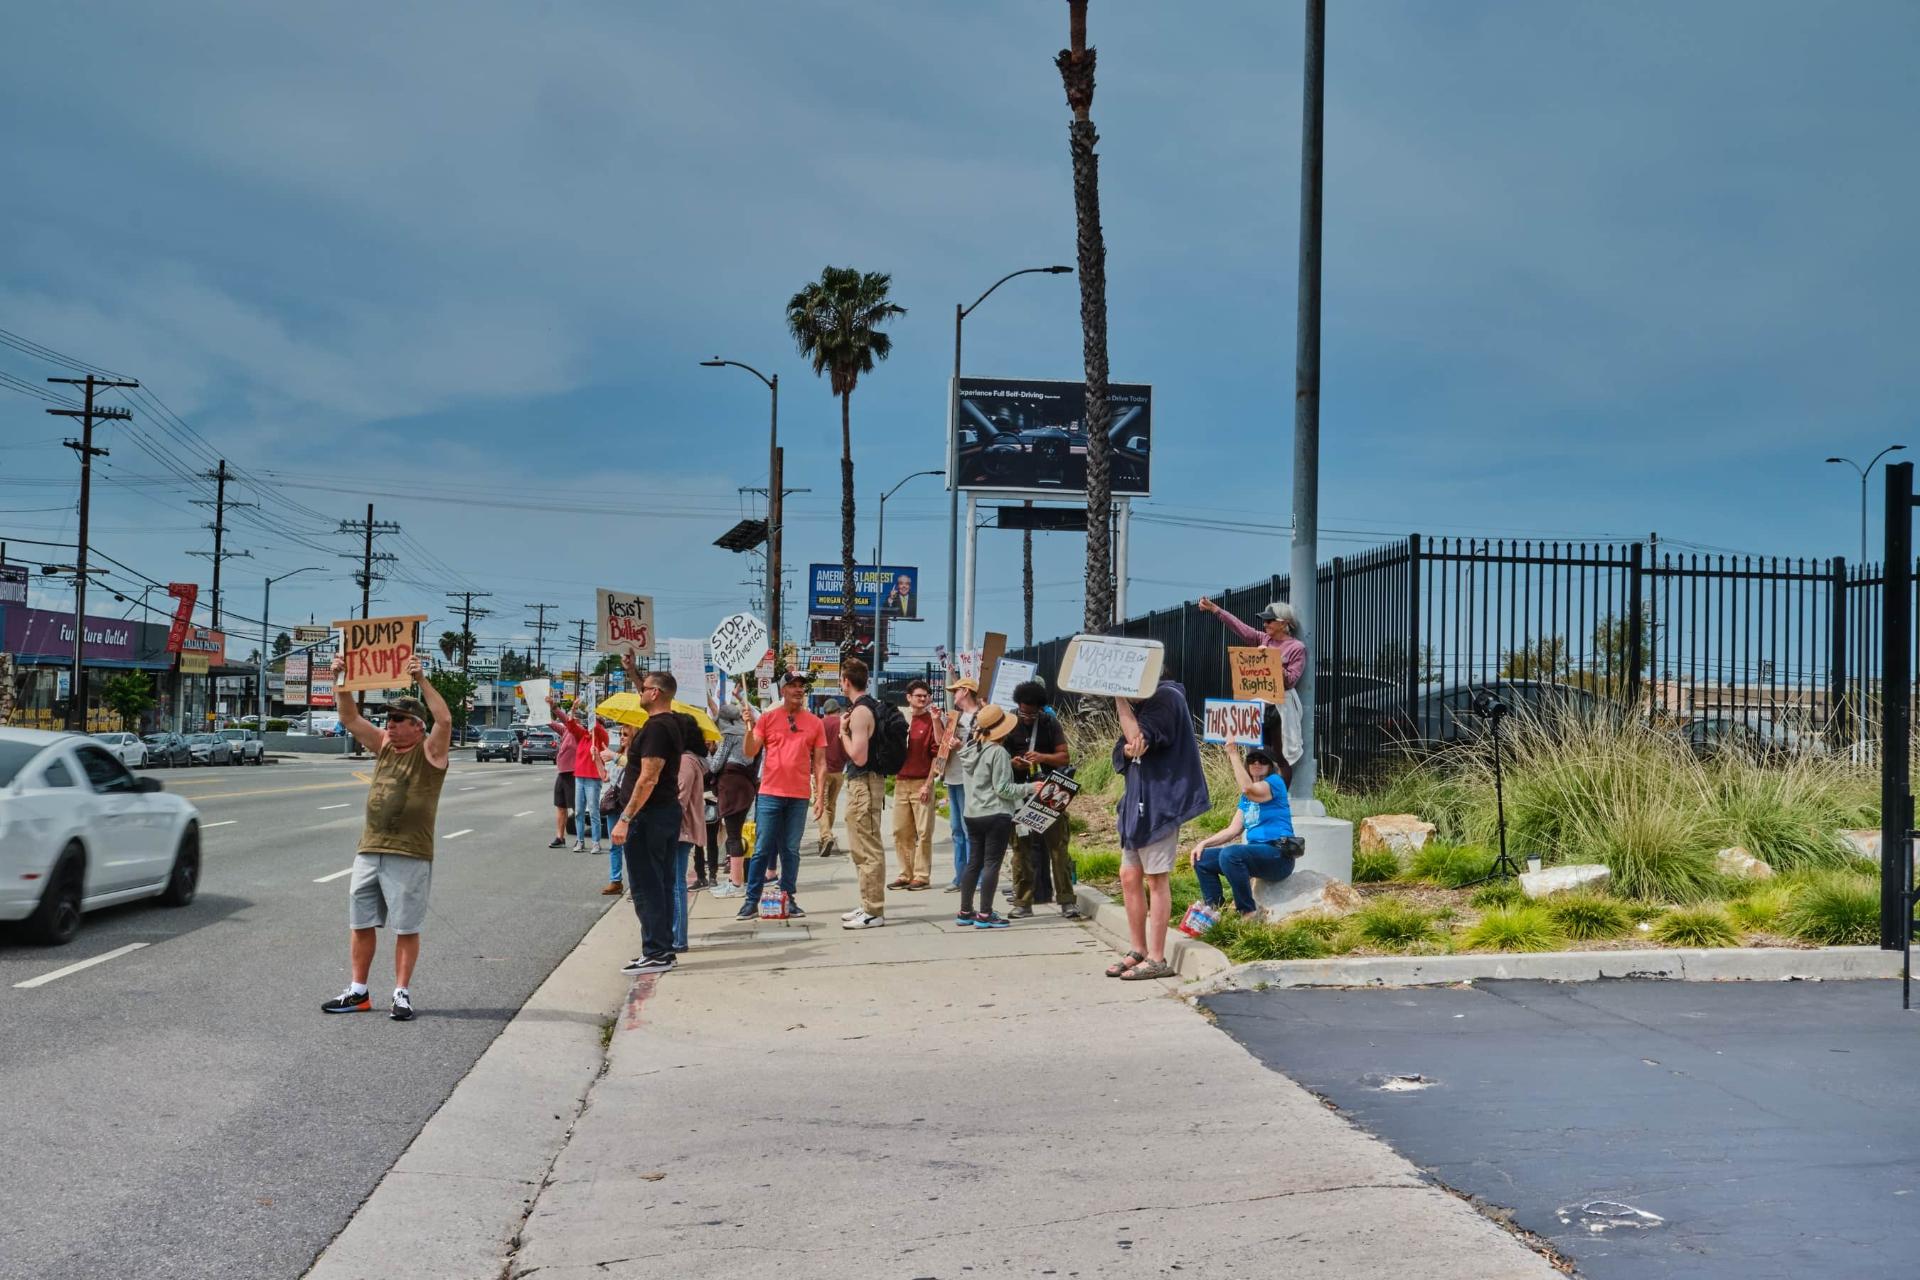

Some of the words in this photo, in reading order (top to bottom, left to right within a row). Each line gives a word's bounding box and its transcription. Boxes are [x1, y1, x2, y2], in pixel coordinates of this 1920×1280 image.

[1006, 390, 1044, 399] Self-Driving
[816, 580, 843, 592] INJURY
[863, 582, 884, 593] FIRT
[860, 572, 895, 584] LAREST
[608, 593, 645, 620] Resist
[818, 596, 841, 604] MORGAN
[60, 623, 102, 644] Furture
[104, 628, 128, 646] Outlet
[352, 621, 404, 649] DUMP
[609, 617, 647, 648] Bullies
[712, 615, 744, 649] STOP
[714, 619, 757, 666] FASCISM
[736, 628, 766, 664] AMERICA
[345, 643, 411, 681] TRUMP
[1205, 706, 1229, 738] THIS
[1230, 704, 1262, 740] SUCKS
[1050, 774, 1064, 784] STOP
[1063, 779, 1079, 791] MUSK
[1026, 811, 1049, 824] SAVE
[1029, 801, 1044, 810] STOP
[1016, 816, 1046, 832] AMERICA!
